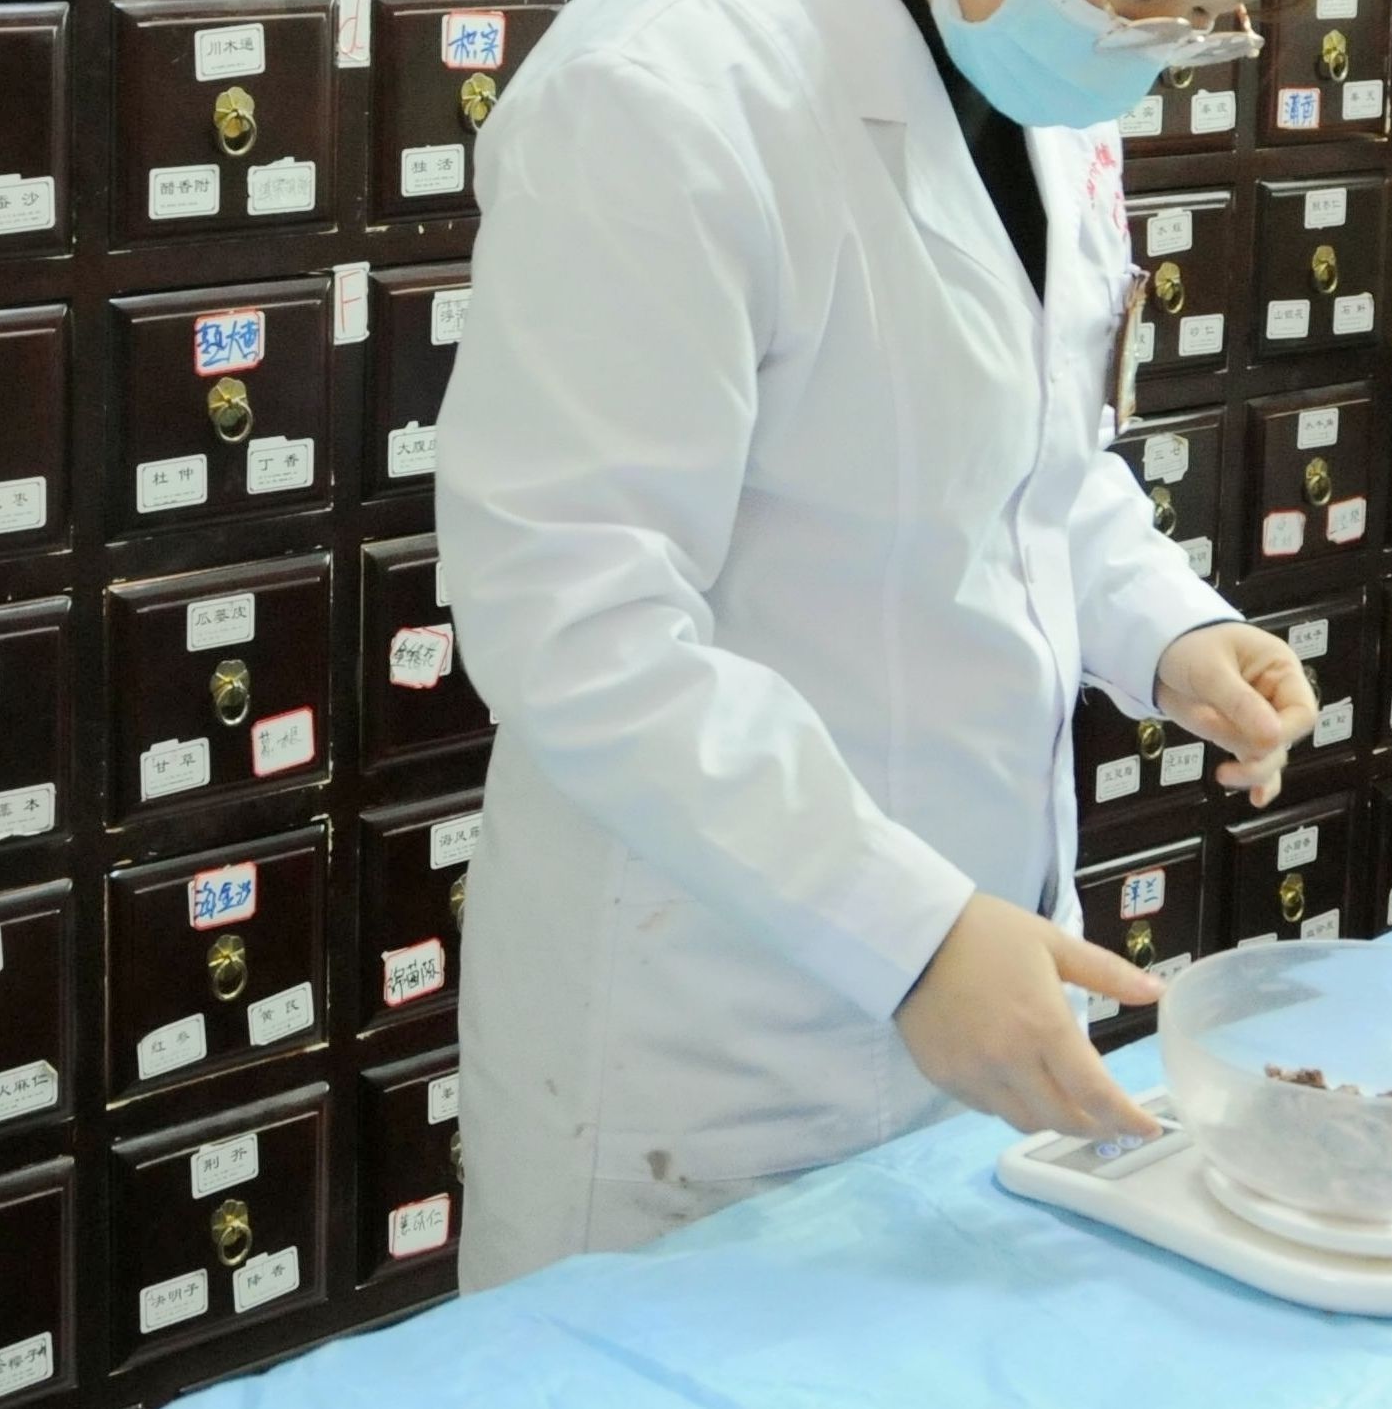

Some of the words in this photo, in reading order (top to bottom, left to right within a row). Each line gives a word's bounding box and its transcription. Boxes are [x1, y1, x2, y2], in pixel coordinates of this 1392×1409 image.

[206, 35, 255, 56] 川木通
[410, 156, 454, 174] 独活
[159, 177, 210, 196] 醋香附
[336, 273, 360, 327] F
[257, 452, 300, 472] 丁香
[151, 466, 194, 486] 杜仲
[152, 751, 196, 774] 甘草
[202, 1145, 248, 1173] 荆芥
